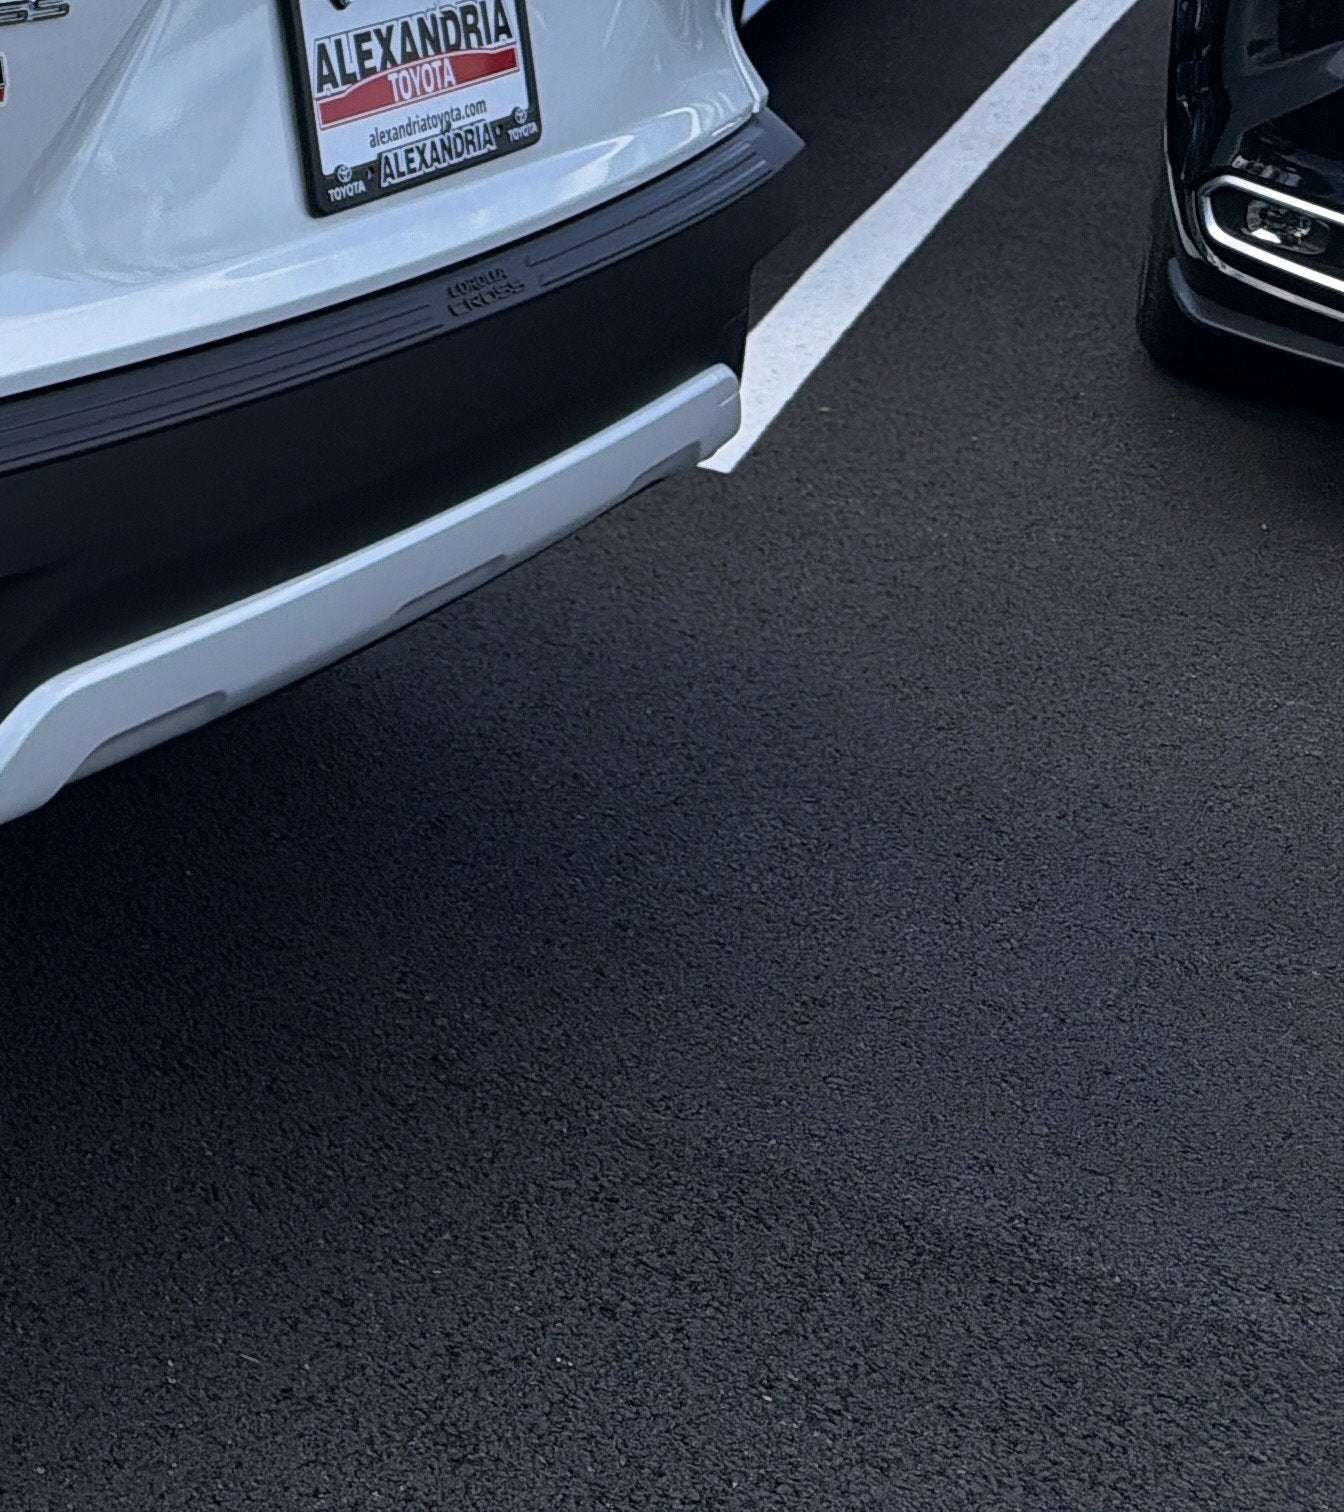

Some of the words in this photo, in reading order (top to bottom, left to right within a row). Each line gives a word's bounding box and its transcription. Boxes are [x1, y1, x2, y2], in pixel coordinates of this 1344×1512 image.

[387, 57, 457, 103] TOYOTA
[368, 98, 488, 148] alexandriatoyota.com
[507, 125, 538, 142] TOYOTA
[380, 123, 496, 186] ALEXANDRIA
[328, 179, 367, 202] TOYOTA
[447, 268, 508, 298] COROLLA
[448, 280, 526, 317] CROSS
